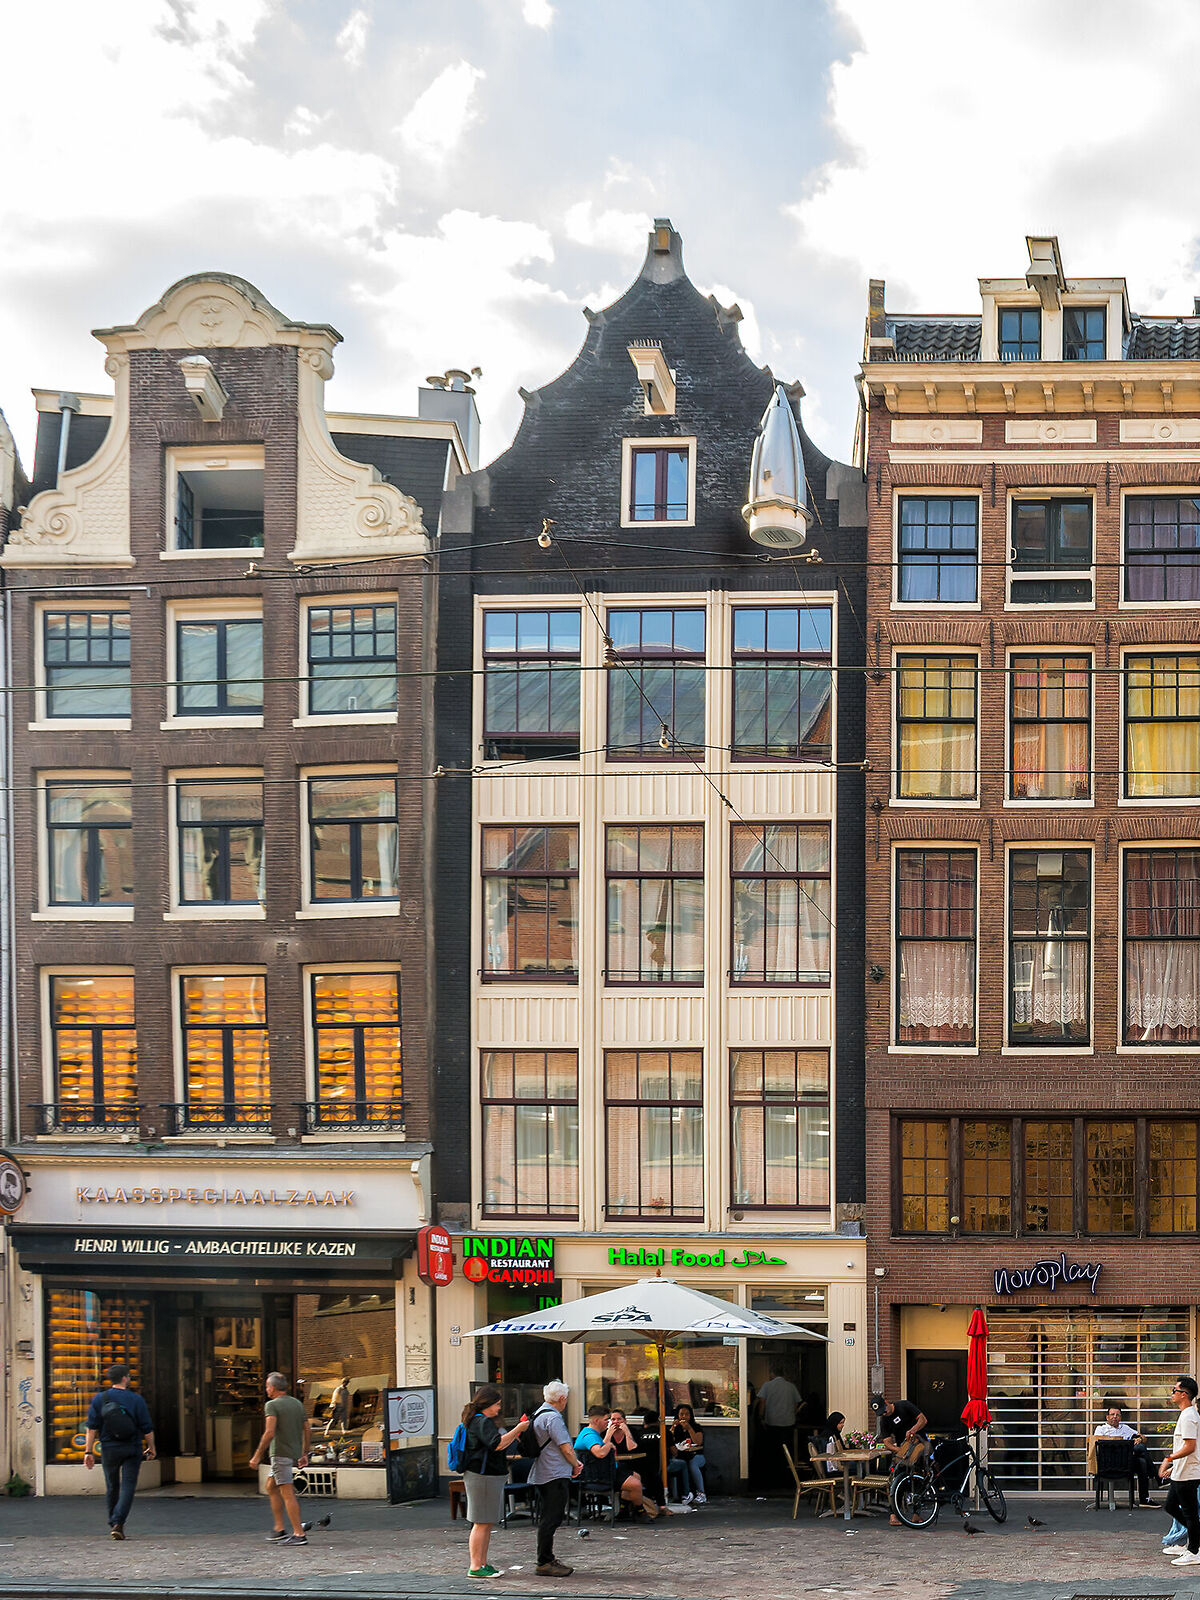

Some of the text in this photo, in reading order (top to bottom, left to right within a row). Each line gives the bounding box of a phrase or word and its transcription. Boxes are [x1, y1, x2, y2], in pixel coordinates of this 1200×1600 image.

[76, 1186, 356, 1206] KAASSPECIAALZAAK
[74, 1239, 117, 1253] HENRI
[122, 1240, 170, 1254] WILLIG
[185, 1240, 303, 1255] AMBACHTELIJKE
[306, 1242, 356, 1256] KAZEN
[463, 1237, 553, 1258] INDIAN
[490, 1259, 551, 1268] RESTAURANT
[608, 1248, 726, 1267] Halal Food
[731, 1249, 788, 1268] حلال
[488, 1269, 554, 1283] GANDHI
[591, 1313, 653, 1323] SPA
[490, 1322, 558, 1332] Halal
[931, 1380, 945, 1390] 52
